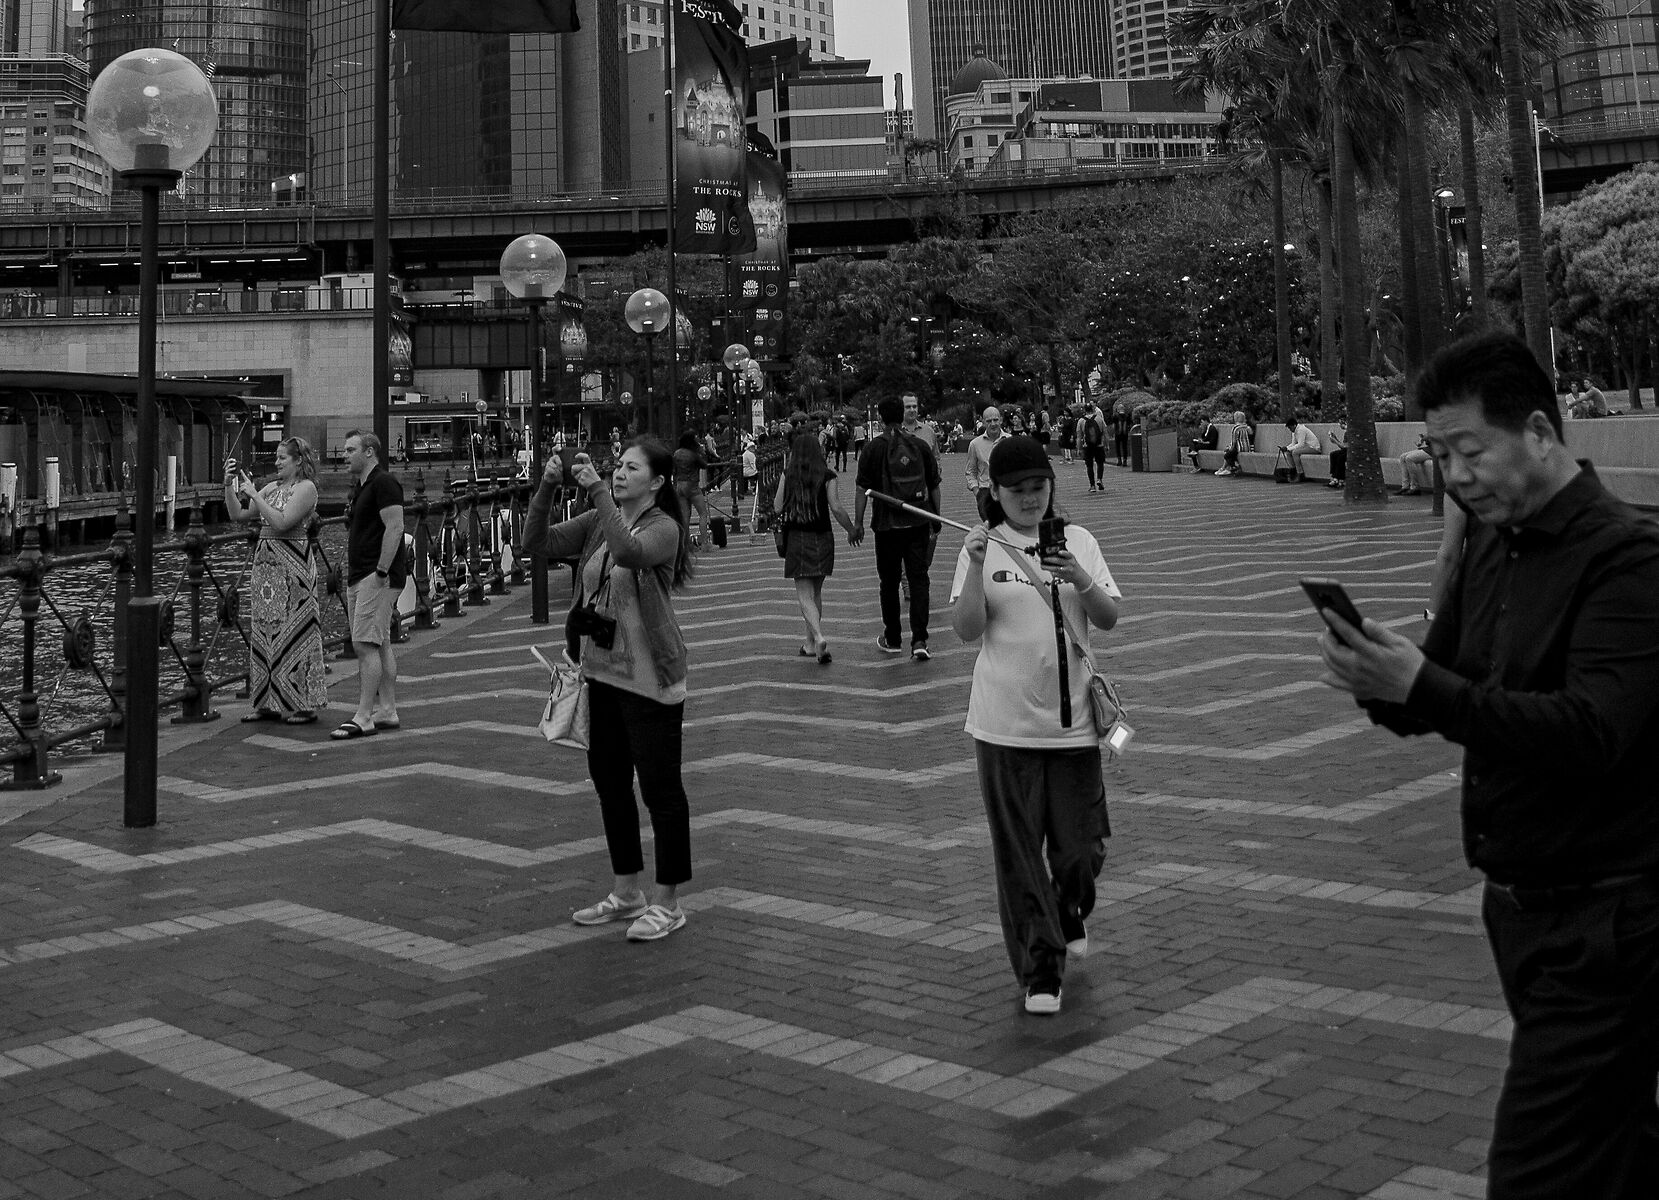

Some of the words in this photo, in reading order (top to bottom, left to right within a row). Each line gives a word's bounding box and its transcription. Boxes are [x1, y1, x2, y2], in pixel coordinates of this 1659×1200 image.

[692, 186, 712, 196] THE
[715, 188, 742, 198] ROCKS
[695, 222, 716, 232] NSW
